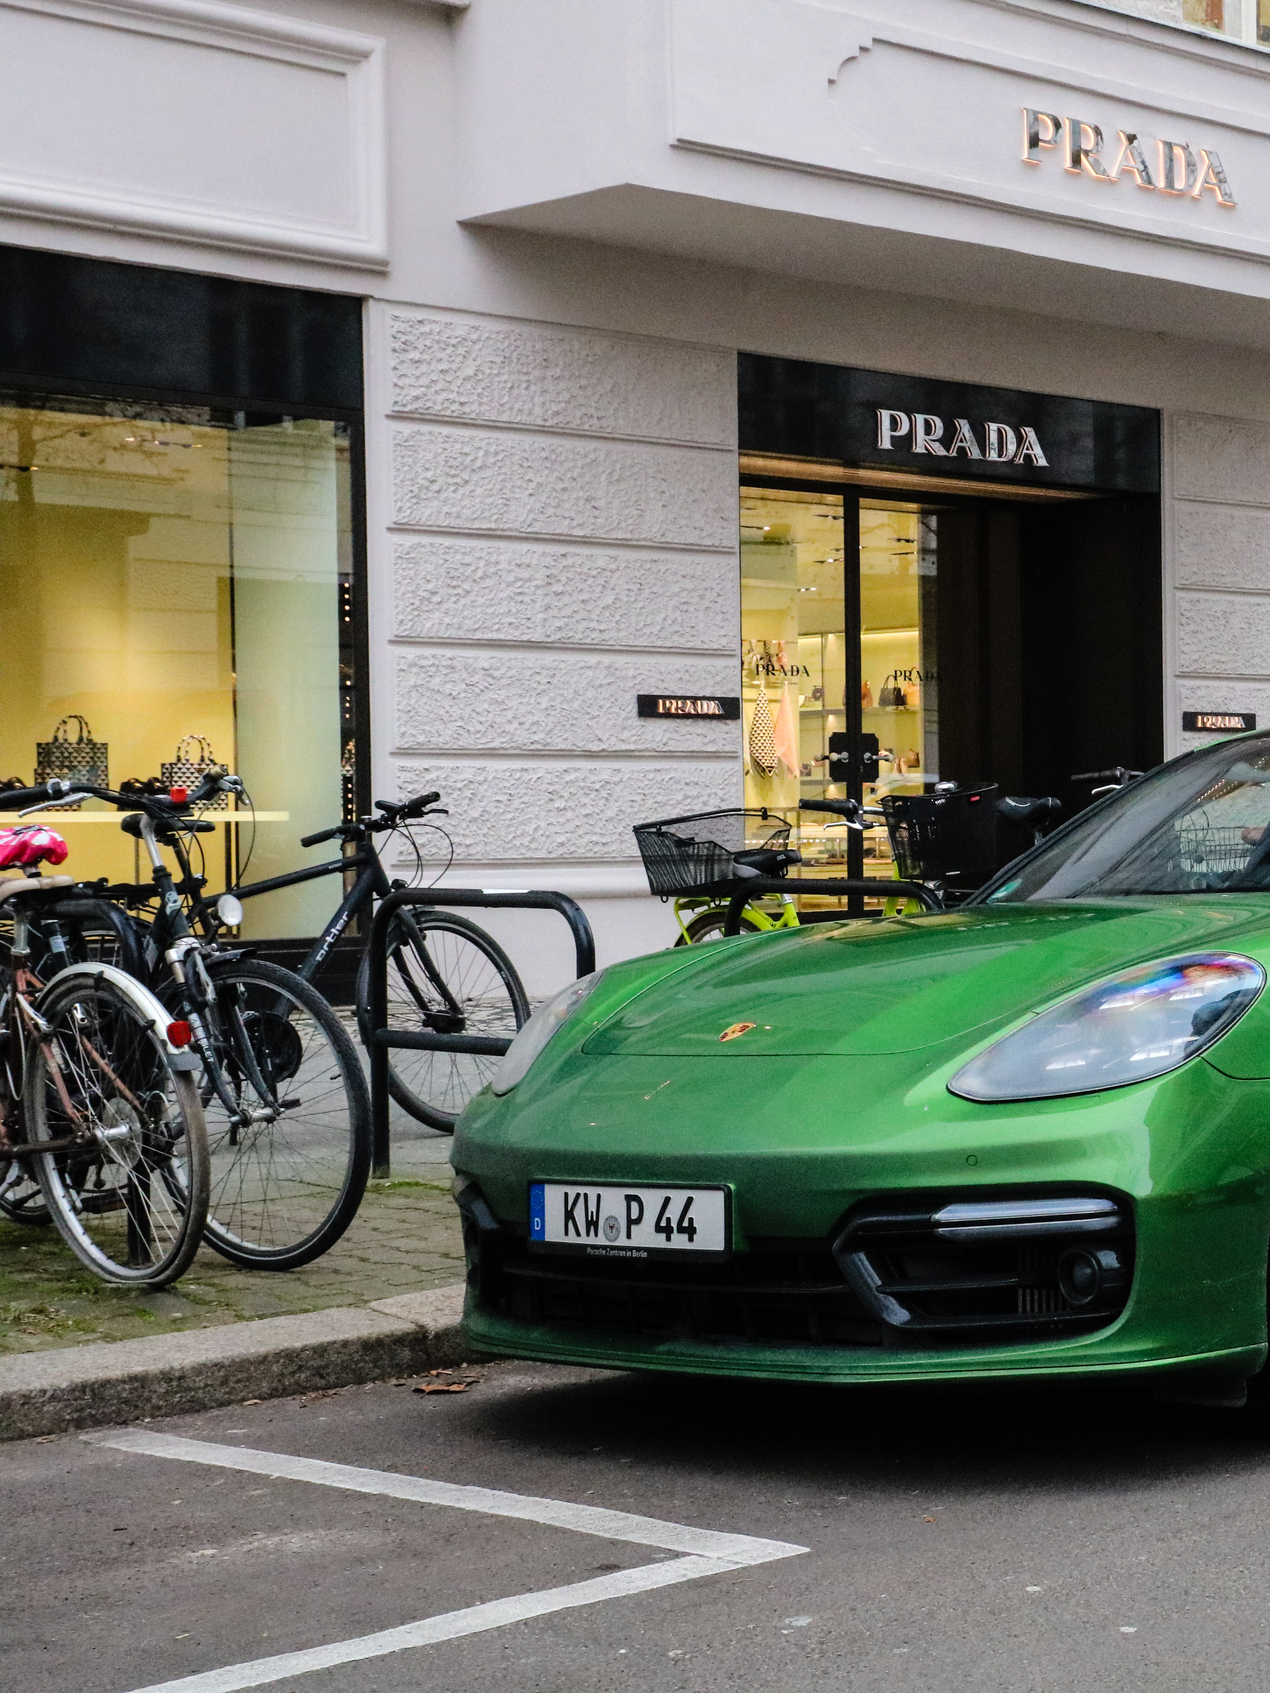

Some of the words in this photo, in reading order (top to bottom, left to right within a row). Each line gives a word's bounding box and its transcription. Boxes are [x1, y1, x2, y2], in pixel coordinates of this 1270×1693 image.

[1021, 106, 1238, 206] PRADA
[876, 408, 1050, 467] PRADA
[755, 663, 810, 677] PRADA
[657, 699, 724, 715] PRADA
[534, 1217, 541, 1231] D
[564, 1191, 602, 1237] KW
[624, 1193, 645, 1240] P
[654, 1196, 697, 1242] 44
[632, 1250, 648, 1258] Berlin
